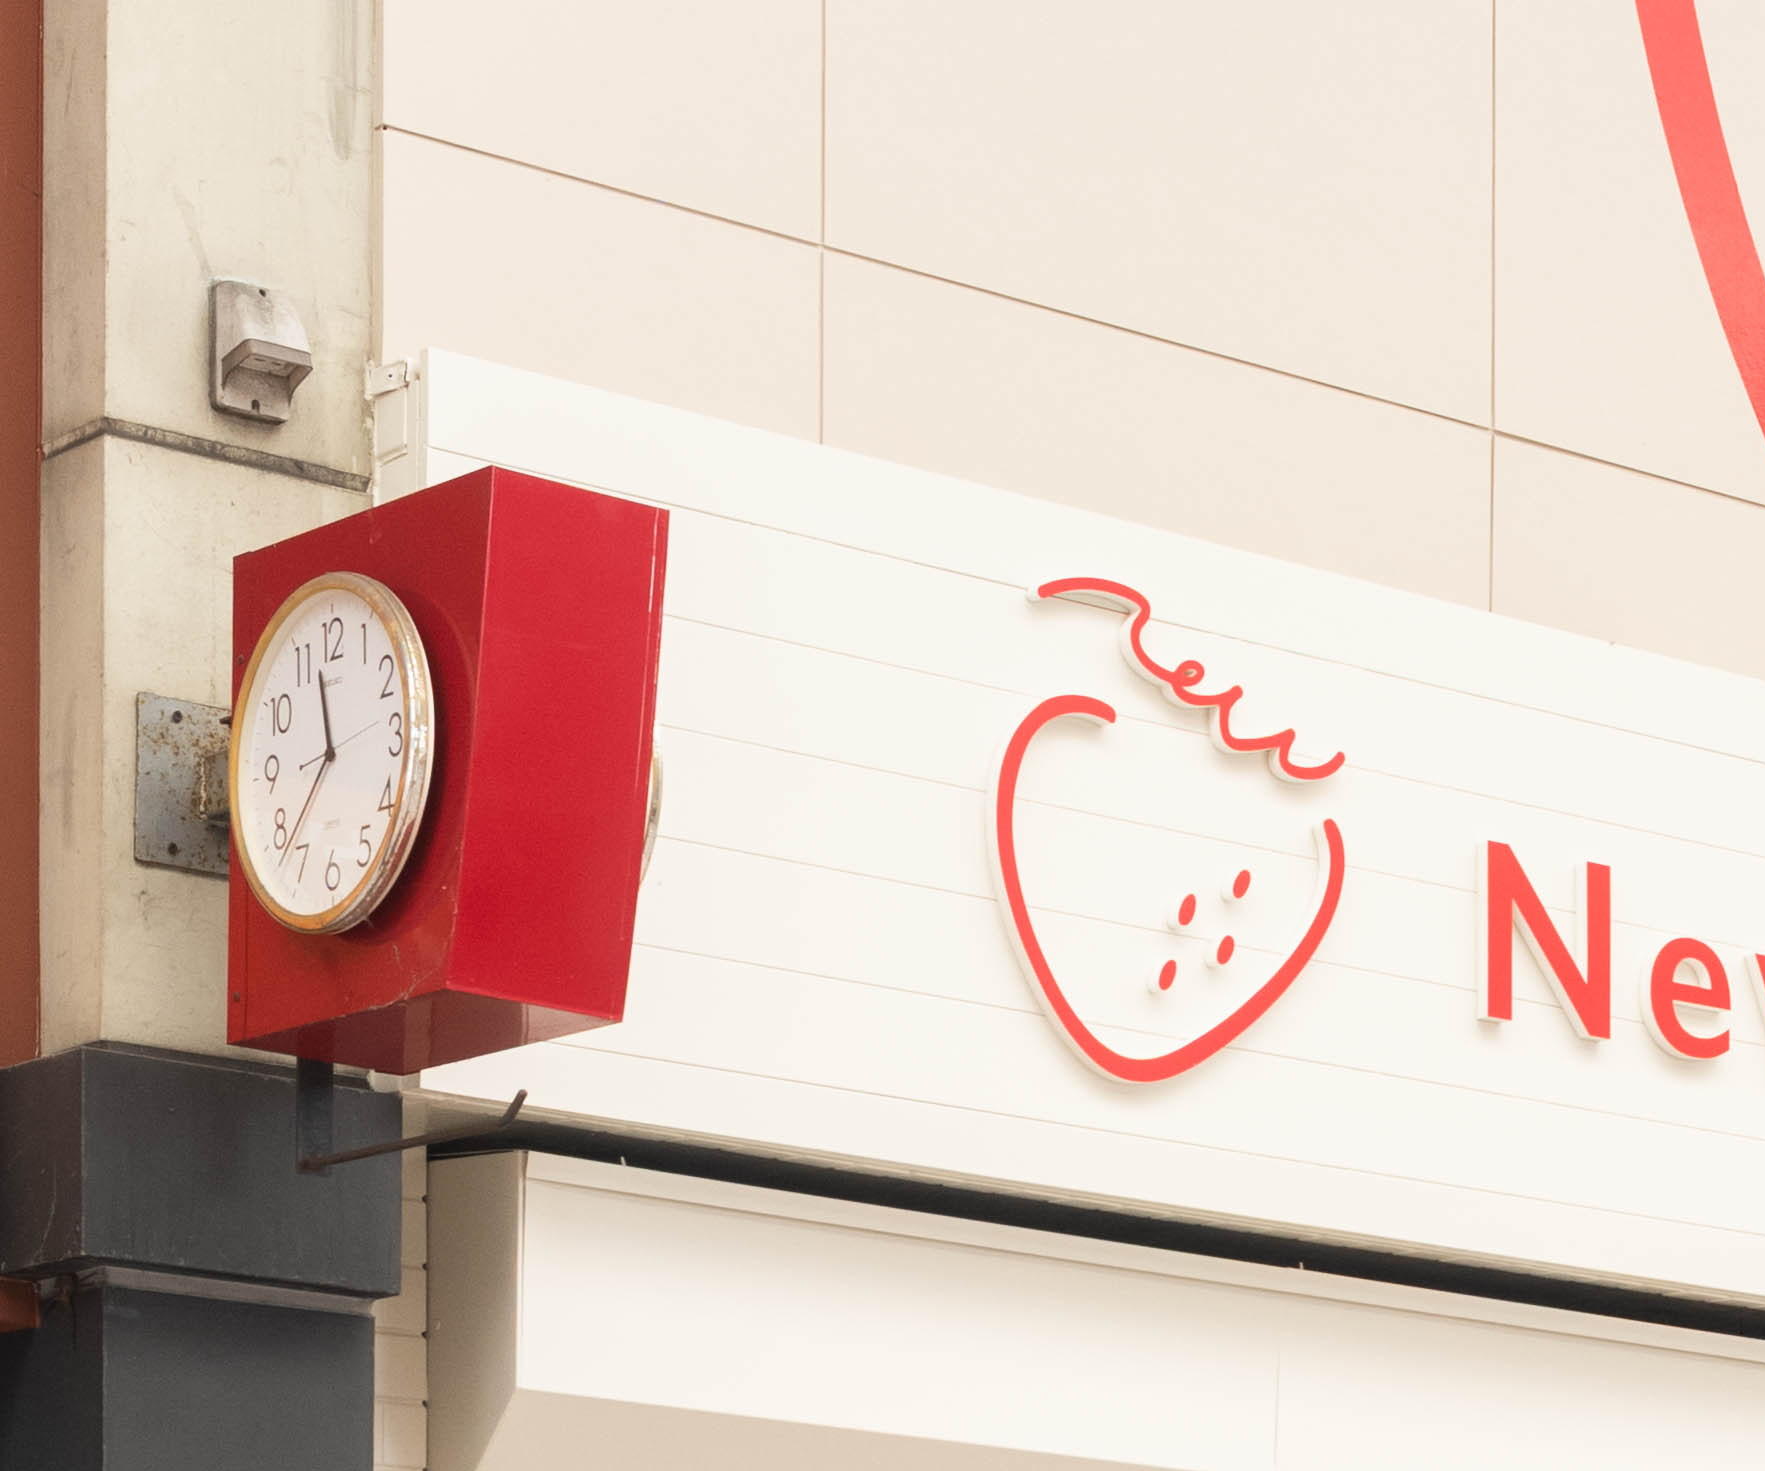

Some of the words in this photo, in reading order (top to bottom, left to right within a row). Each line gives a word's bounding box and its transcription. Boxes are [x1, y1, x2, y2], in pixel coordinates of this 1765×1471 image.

[321, 616, 344, 664] 12
[295, 643, 311, 689] 11
[378, 654, 395, 700] 2
[270, 693, 293, 737] 10
[388, 711, 403, 757] 3
[264, 754, 280, 795] 9
[377, 775, 395, 817] 4
[273, 807, 287, 851] 8
[356, 824, 372, 868] 5
[295, 843, 310, 884] 7
[325, 848, 341, 891] 6
